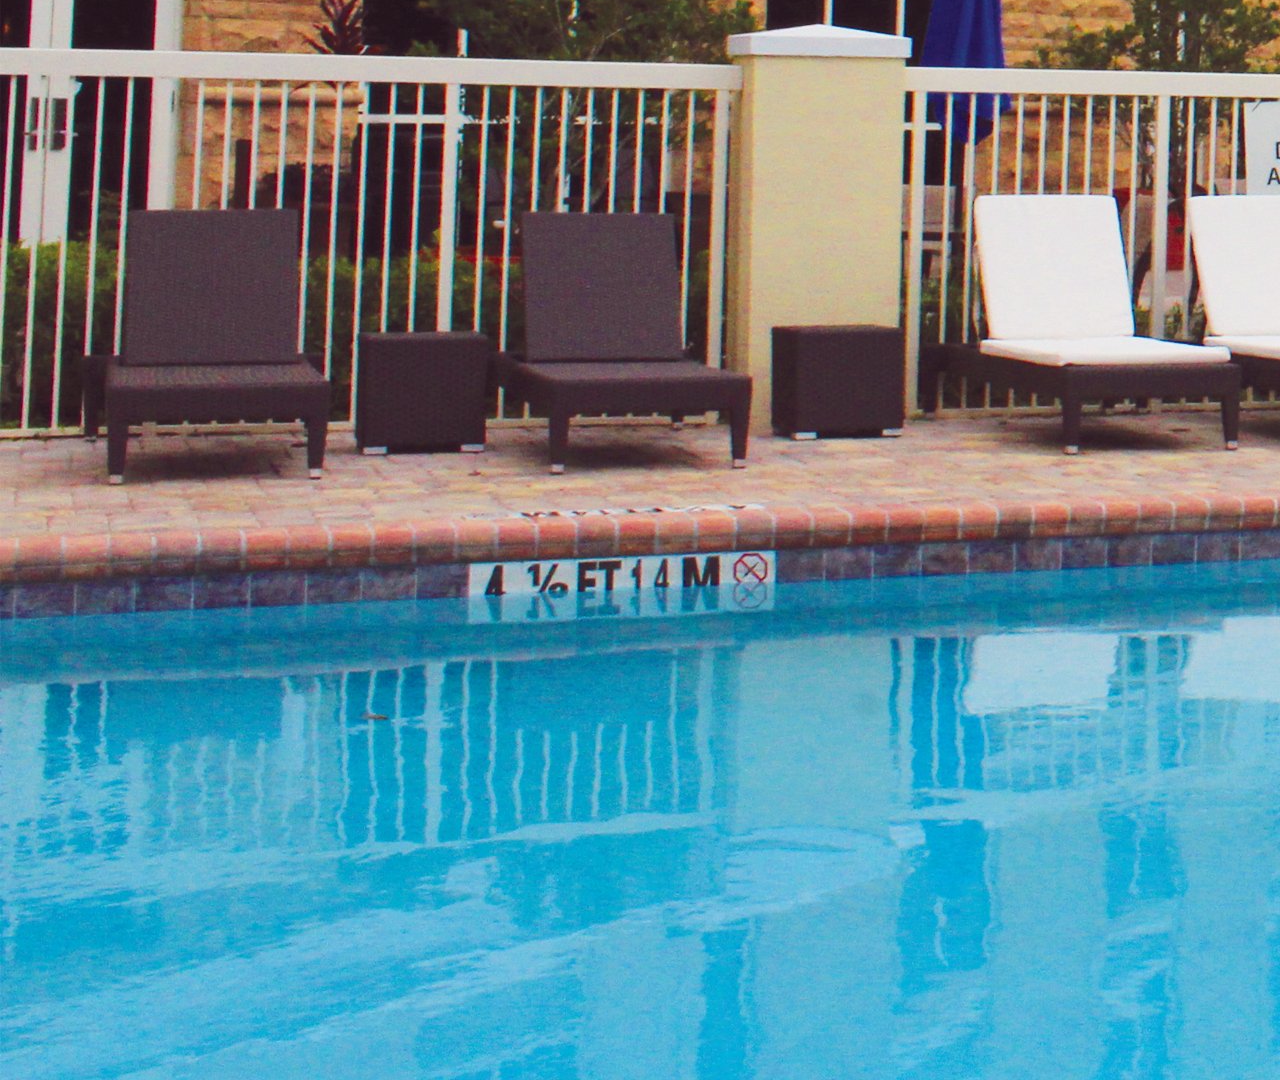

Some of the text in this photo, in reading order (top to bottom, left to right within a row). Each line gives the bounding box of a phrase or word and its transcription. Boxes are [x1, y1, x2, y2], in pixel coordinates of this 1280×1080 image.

[485, 564, 506, 596] 4
[577, 559, 622, 593] FT
[682, 555, 720, 588] M
